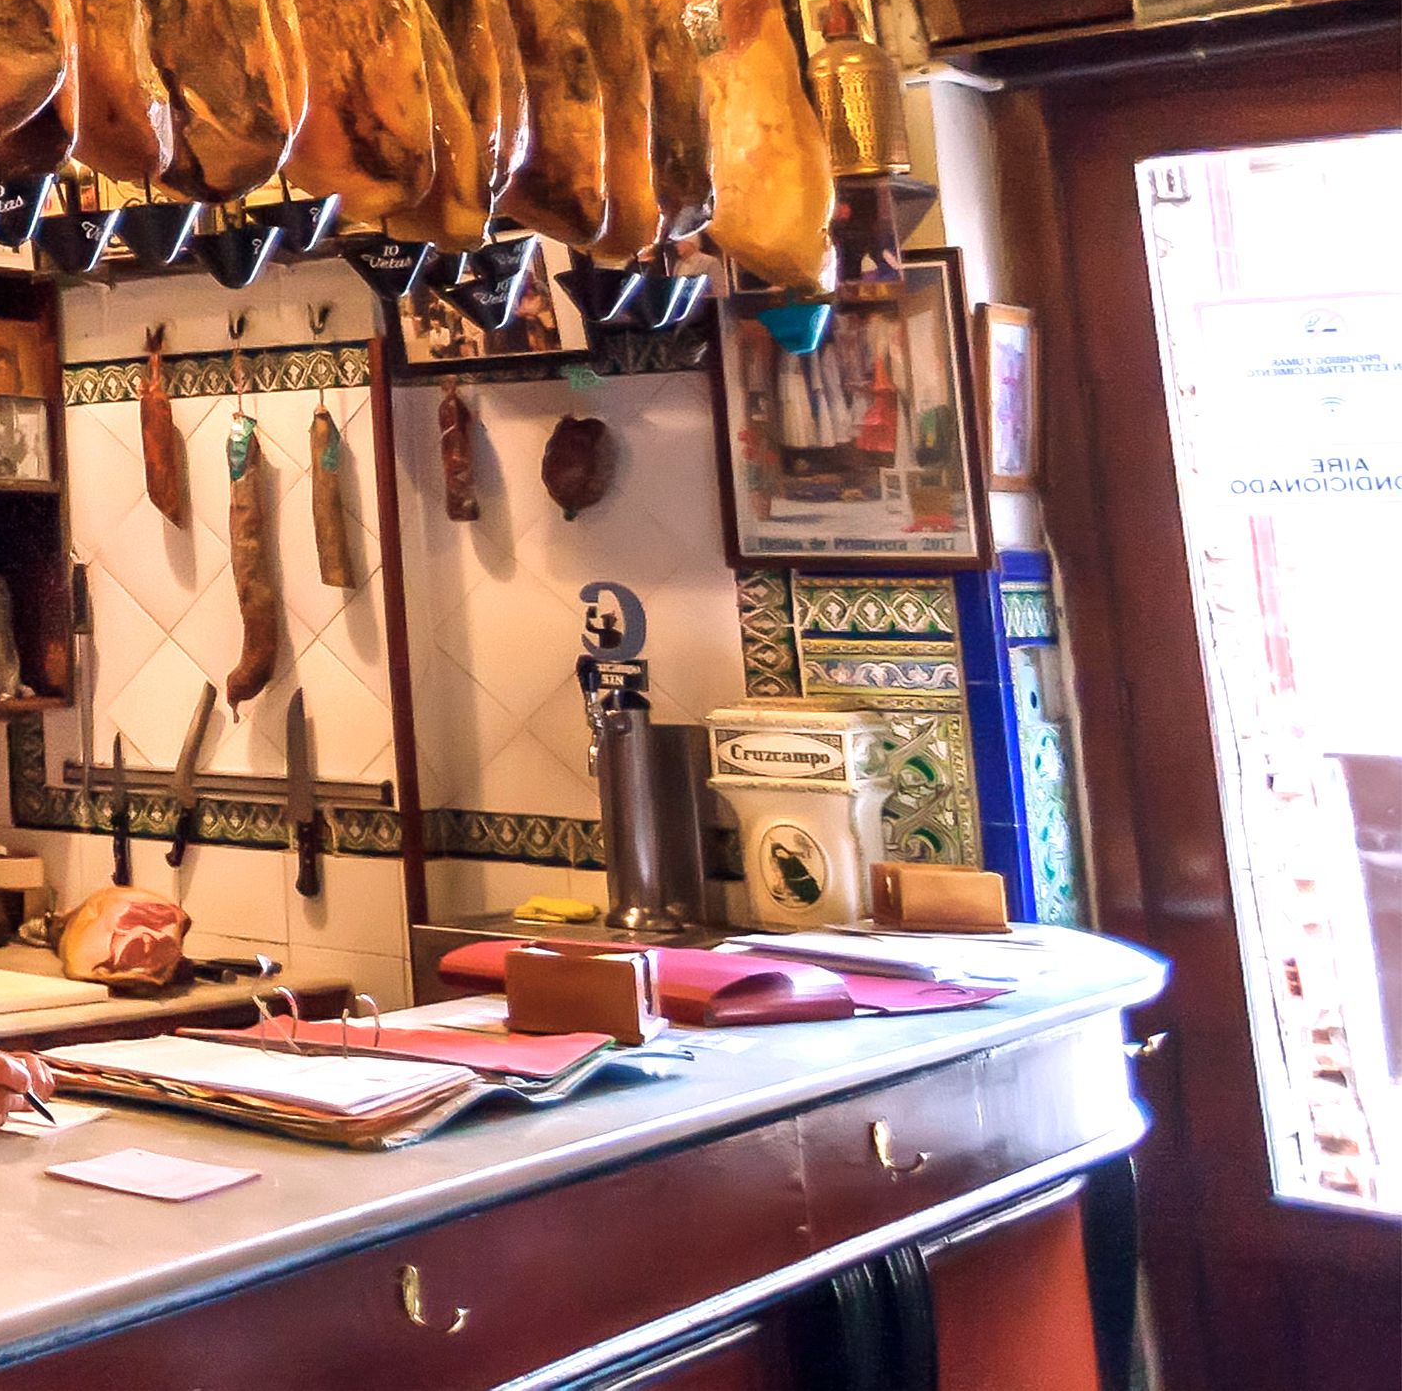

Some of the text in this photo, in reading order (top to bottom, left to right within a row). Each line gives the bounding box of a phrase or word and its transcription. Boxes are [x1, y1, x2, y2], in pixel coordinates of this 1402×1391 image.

[382, 245, 400, 257] 10
[921, 537, 956, 552] 2017
[729, 743, 831, 769] Cruzcampo
